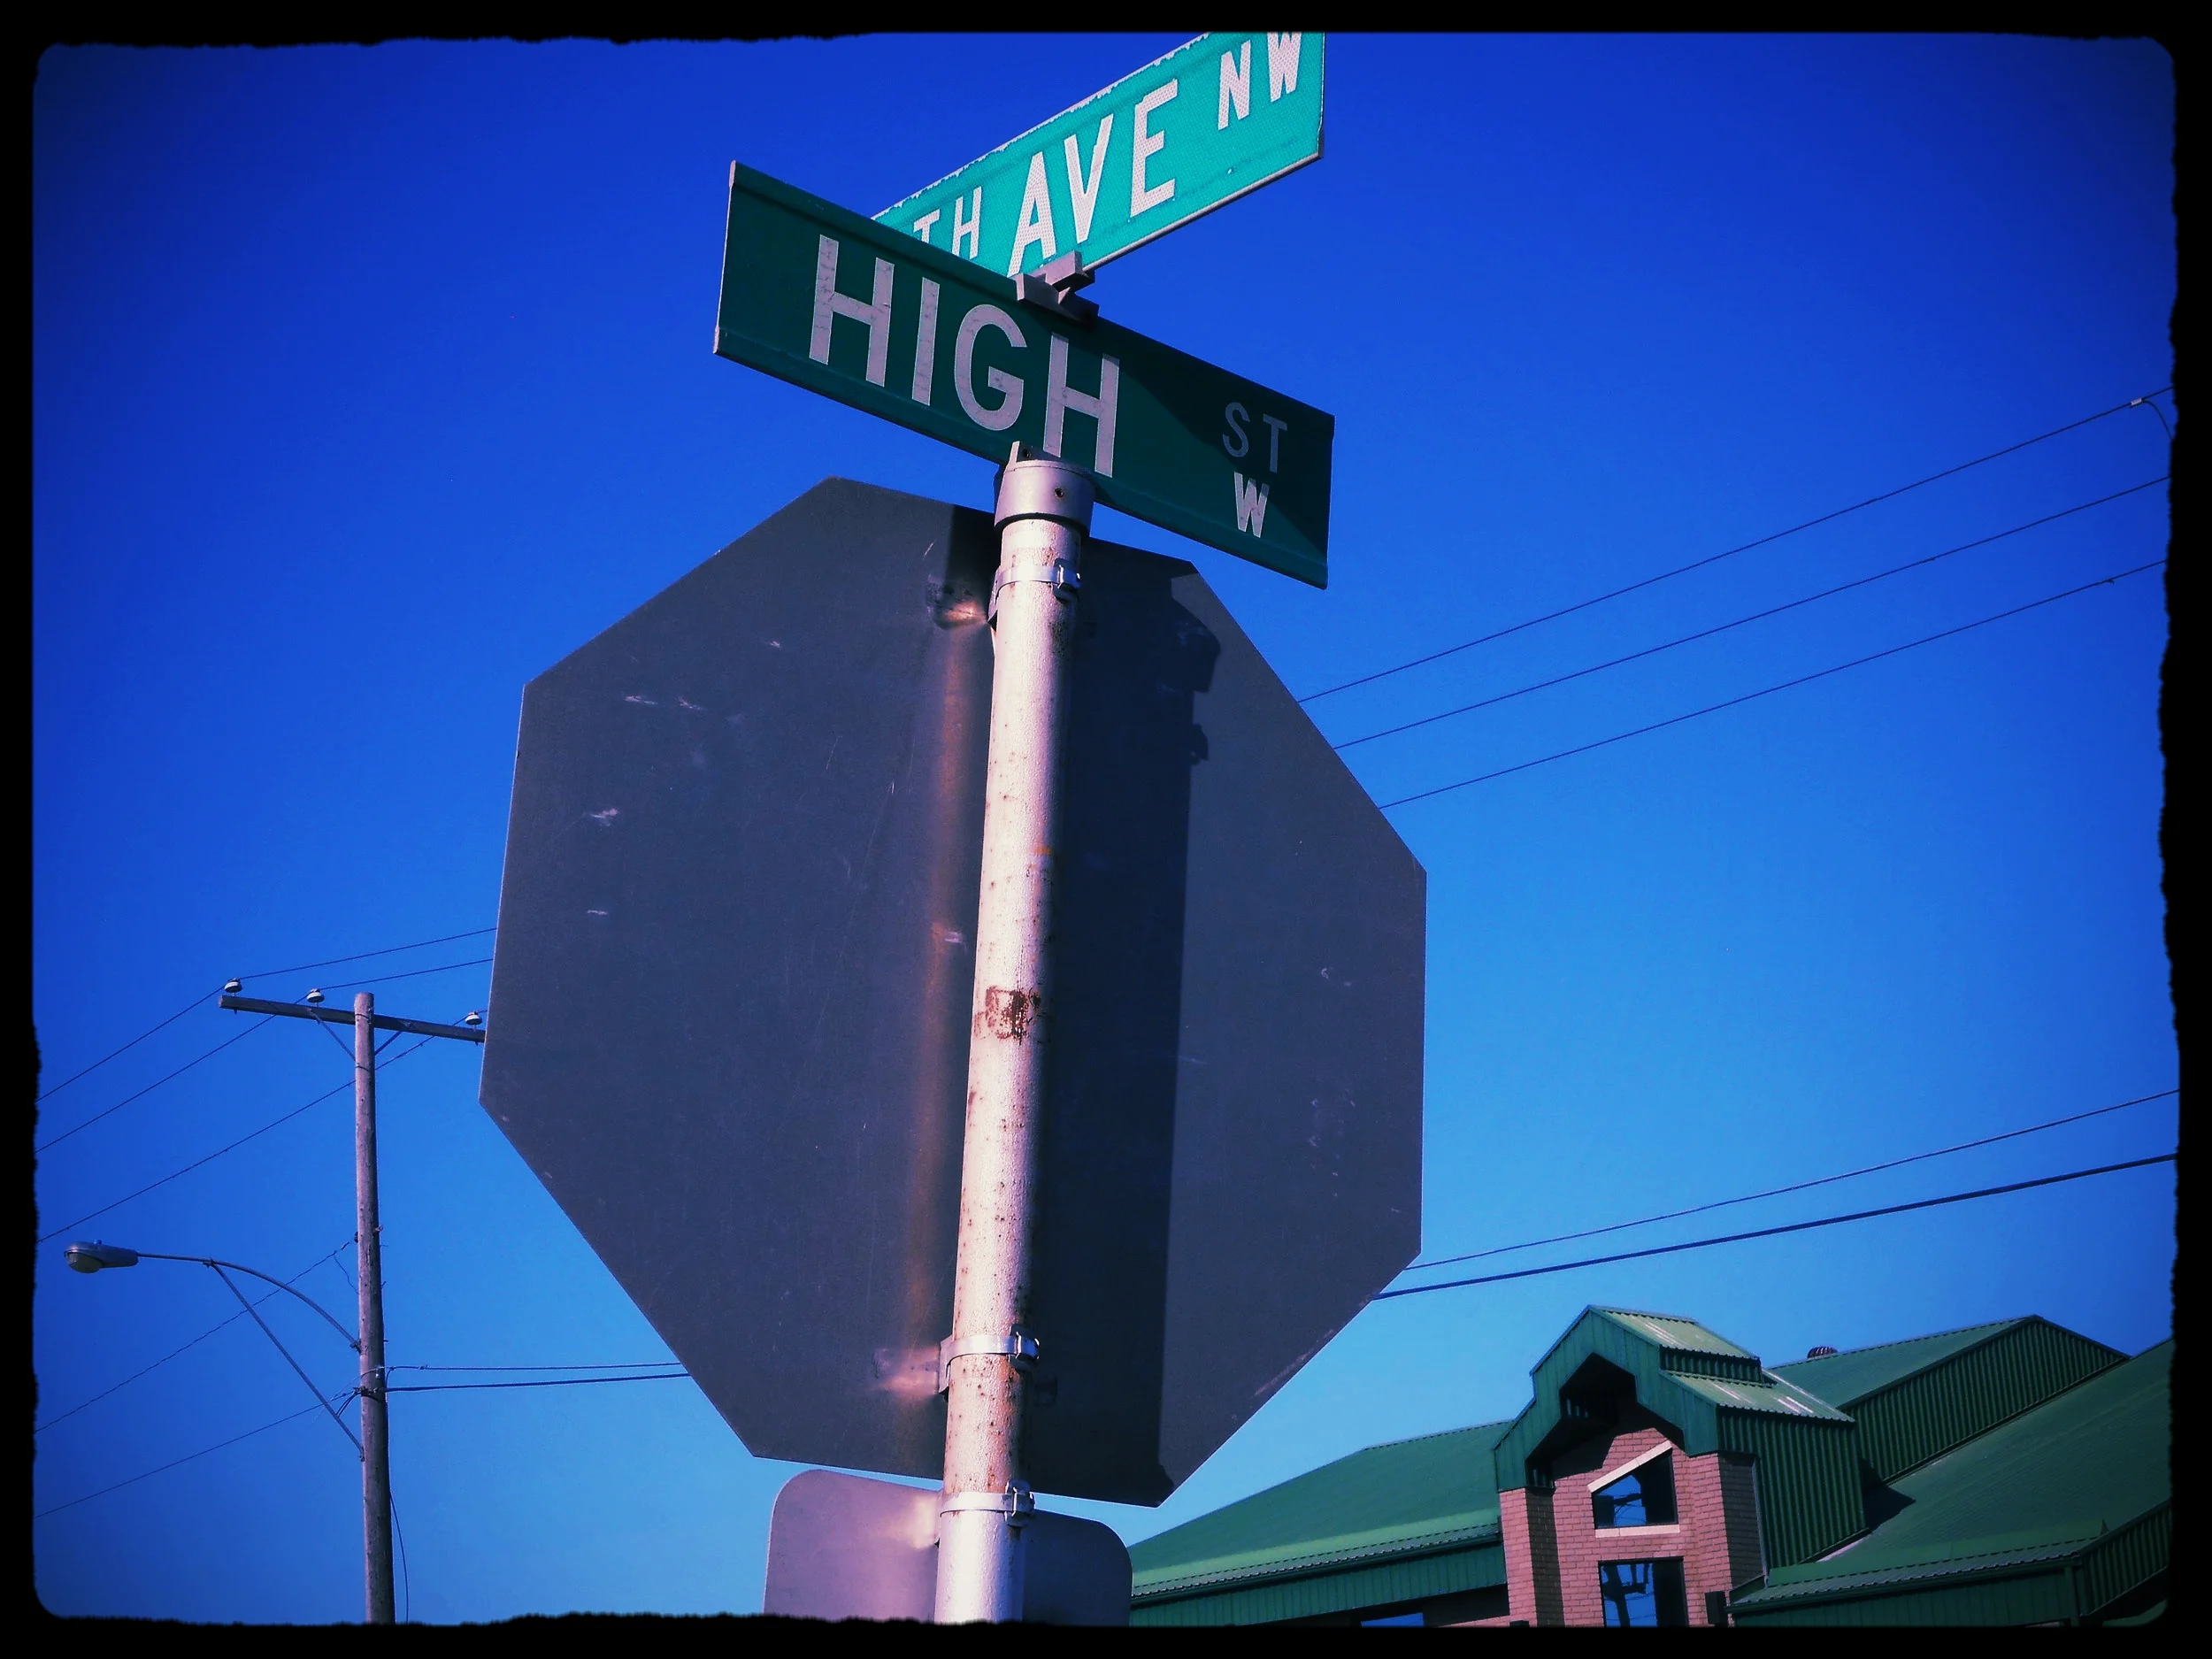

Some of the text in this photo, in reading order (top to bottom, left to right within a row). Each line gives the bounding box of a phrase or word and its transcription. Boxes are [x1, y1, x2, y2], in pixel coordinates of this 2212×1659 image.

[913, 32, 1302, 278] TH AVE NW
[809, 234, 1287, 478] HIGH ST
[1233, 471, 1270, 539] W
